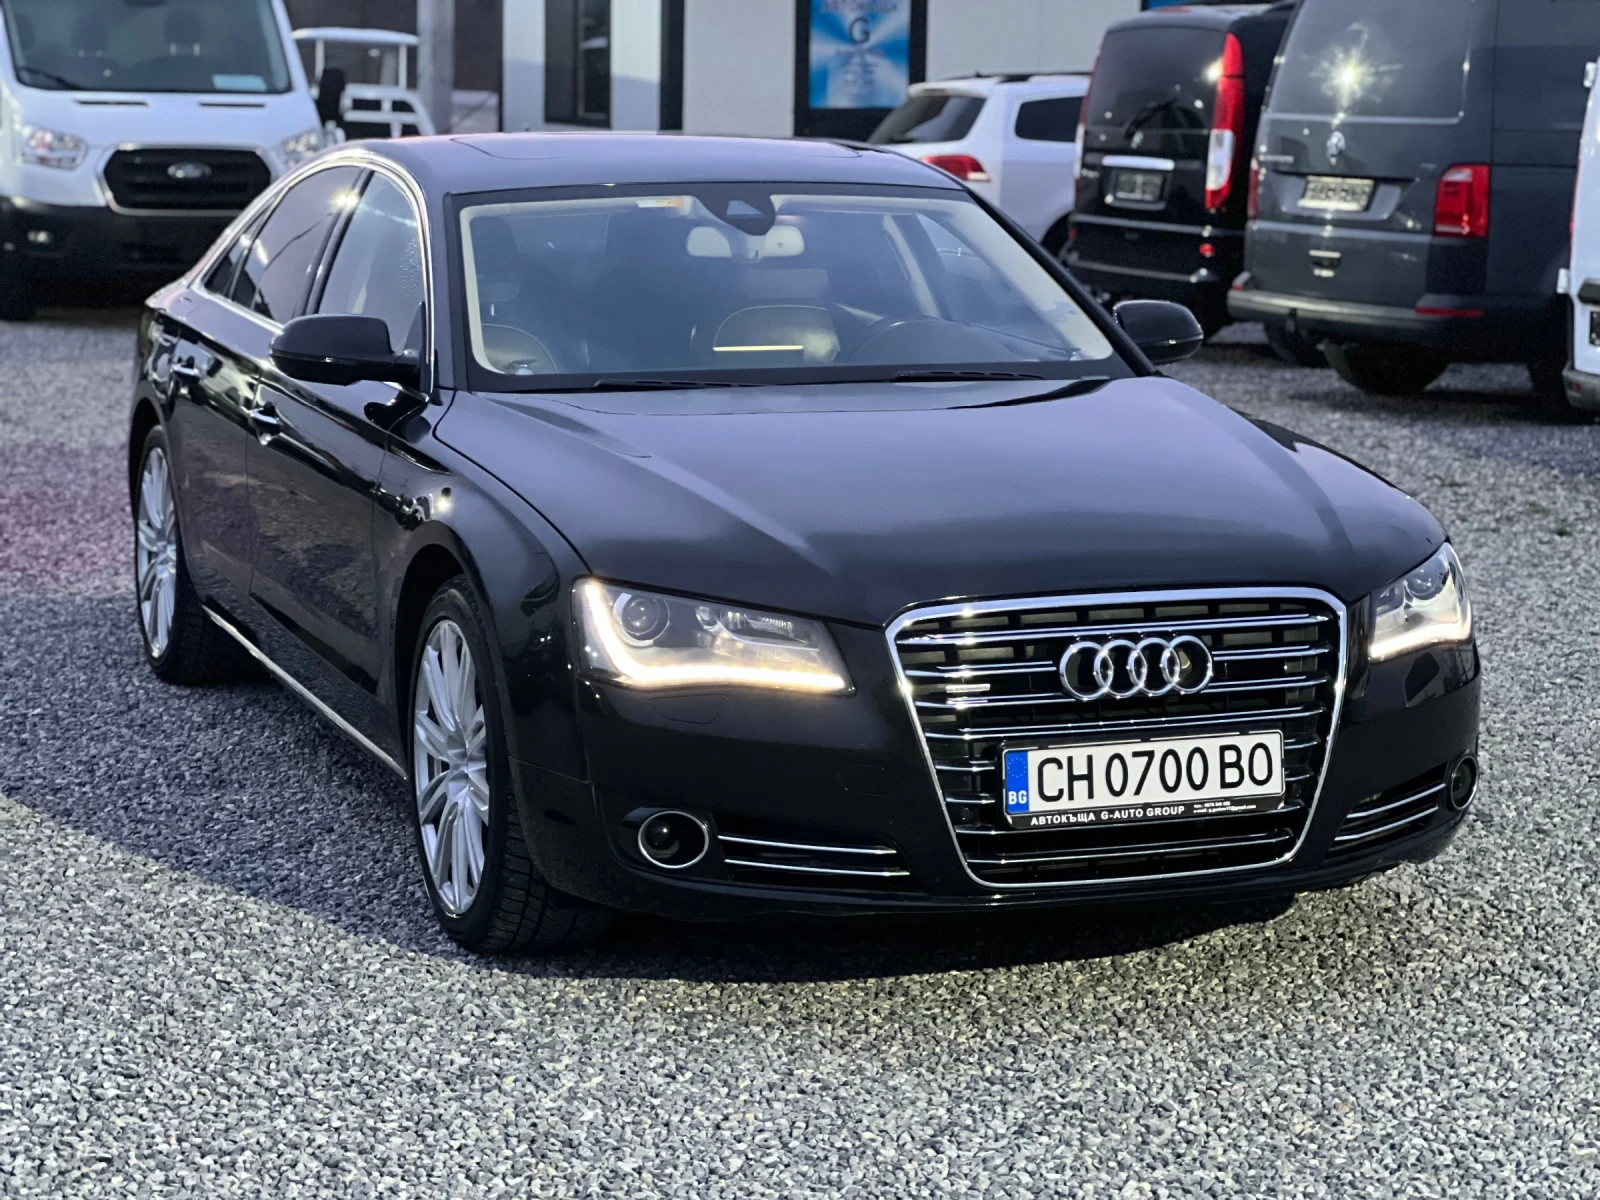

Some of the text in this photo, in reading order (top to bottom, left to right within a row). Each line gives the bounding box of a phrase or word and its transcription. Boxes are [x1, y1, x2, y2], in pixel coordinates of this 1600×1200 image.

[849, 17, 870, 44] G
[1037, 742, 1273, 802] CH 0700 BO
[1008, 790, 1027, 805] BG
[1030, 812, 1096, 826] АВТОКЪЩА
[1101, 807, 1144, 821] G-AUTO
[1146, 805, 1185, 818] GROUP
